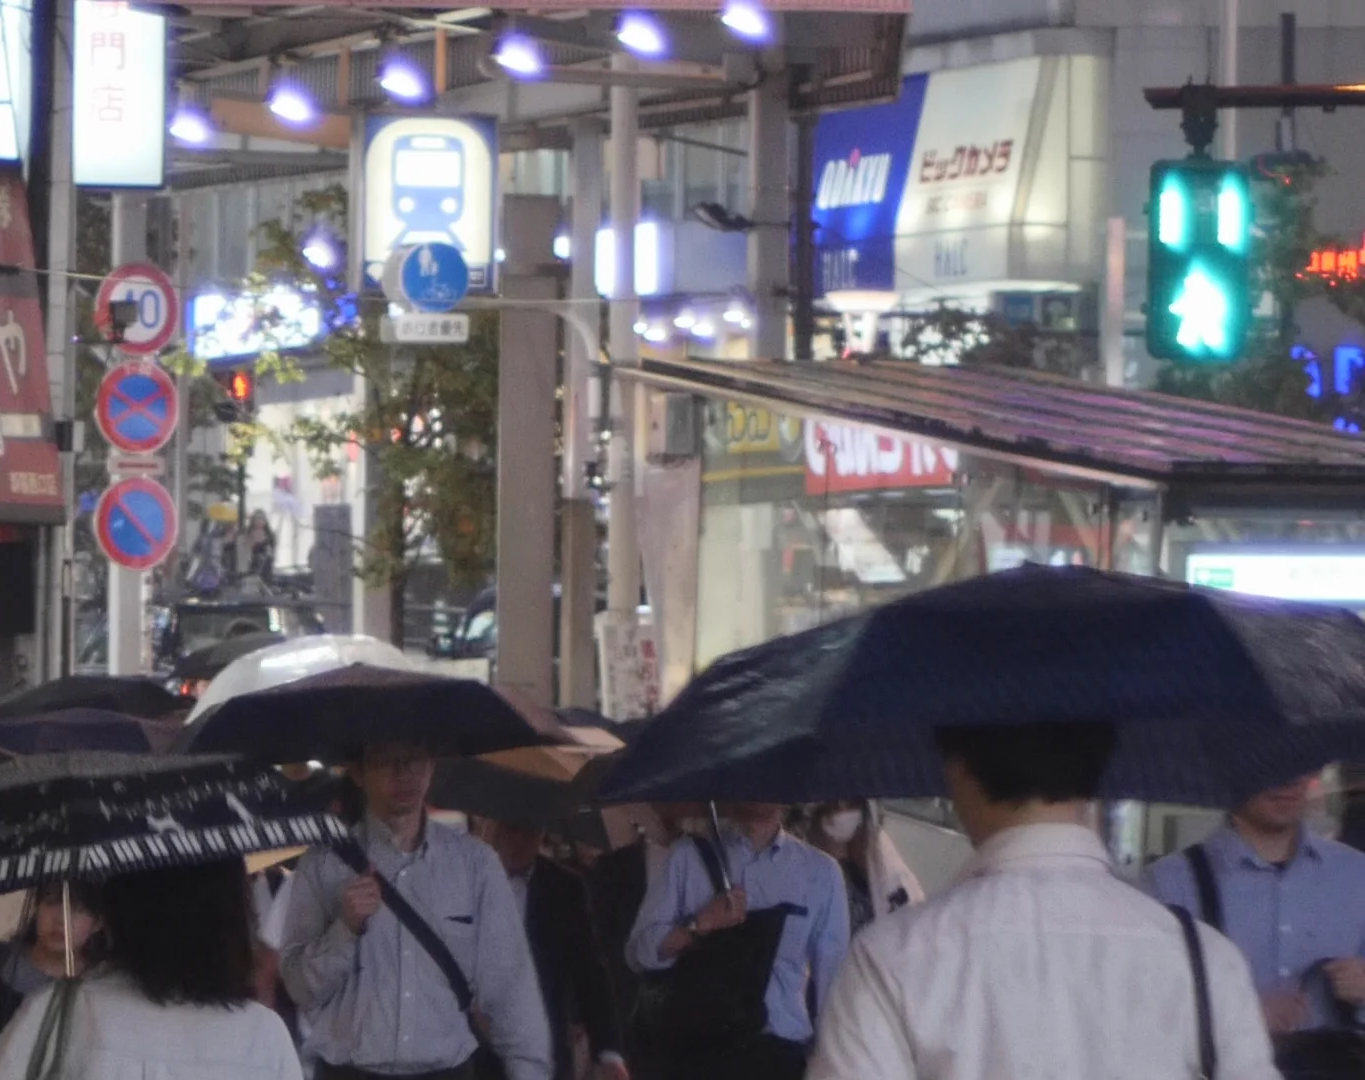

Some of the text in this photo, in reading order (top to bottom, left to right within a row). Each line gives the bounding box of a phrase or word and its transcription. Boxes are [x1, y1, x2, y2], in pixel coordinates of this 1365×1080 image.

[816, 153, 891, 210] ODAKYU
[919, 139, 1014, 184] ビックカメラ
[124, 288, 161, 329] 0
